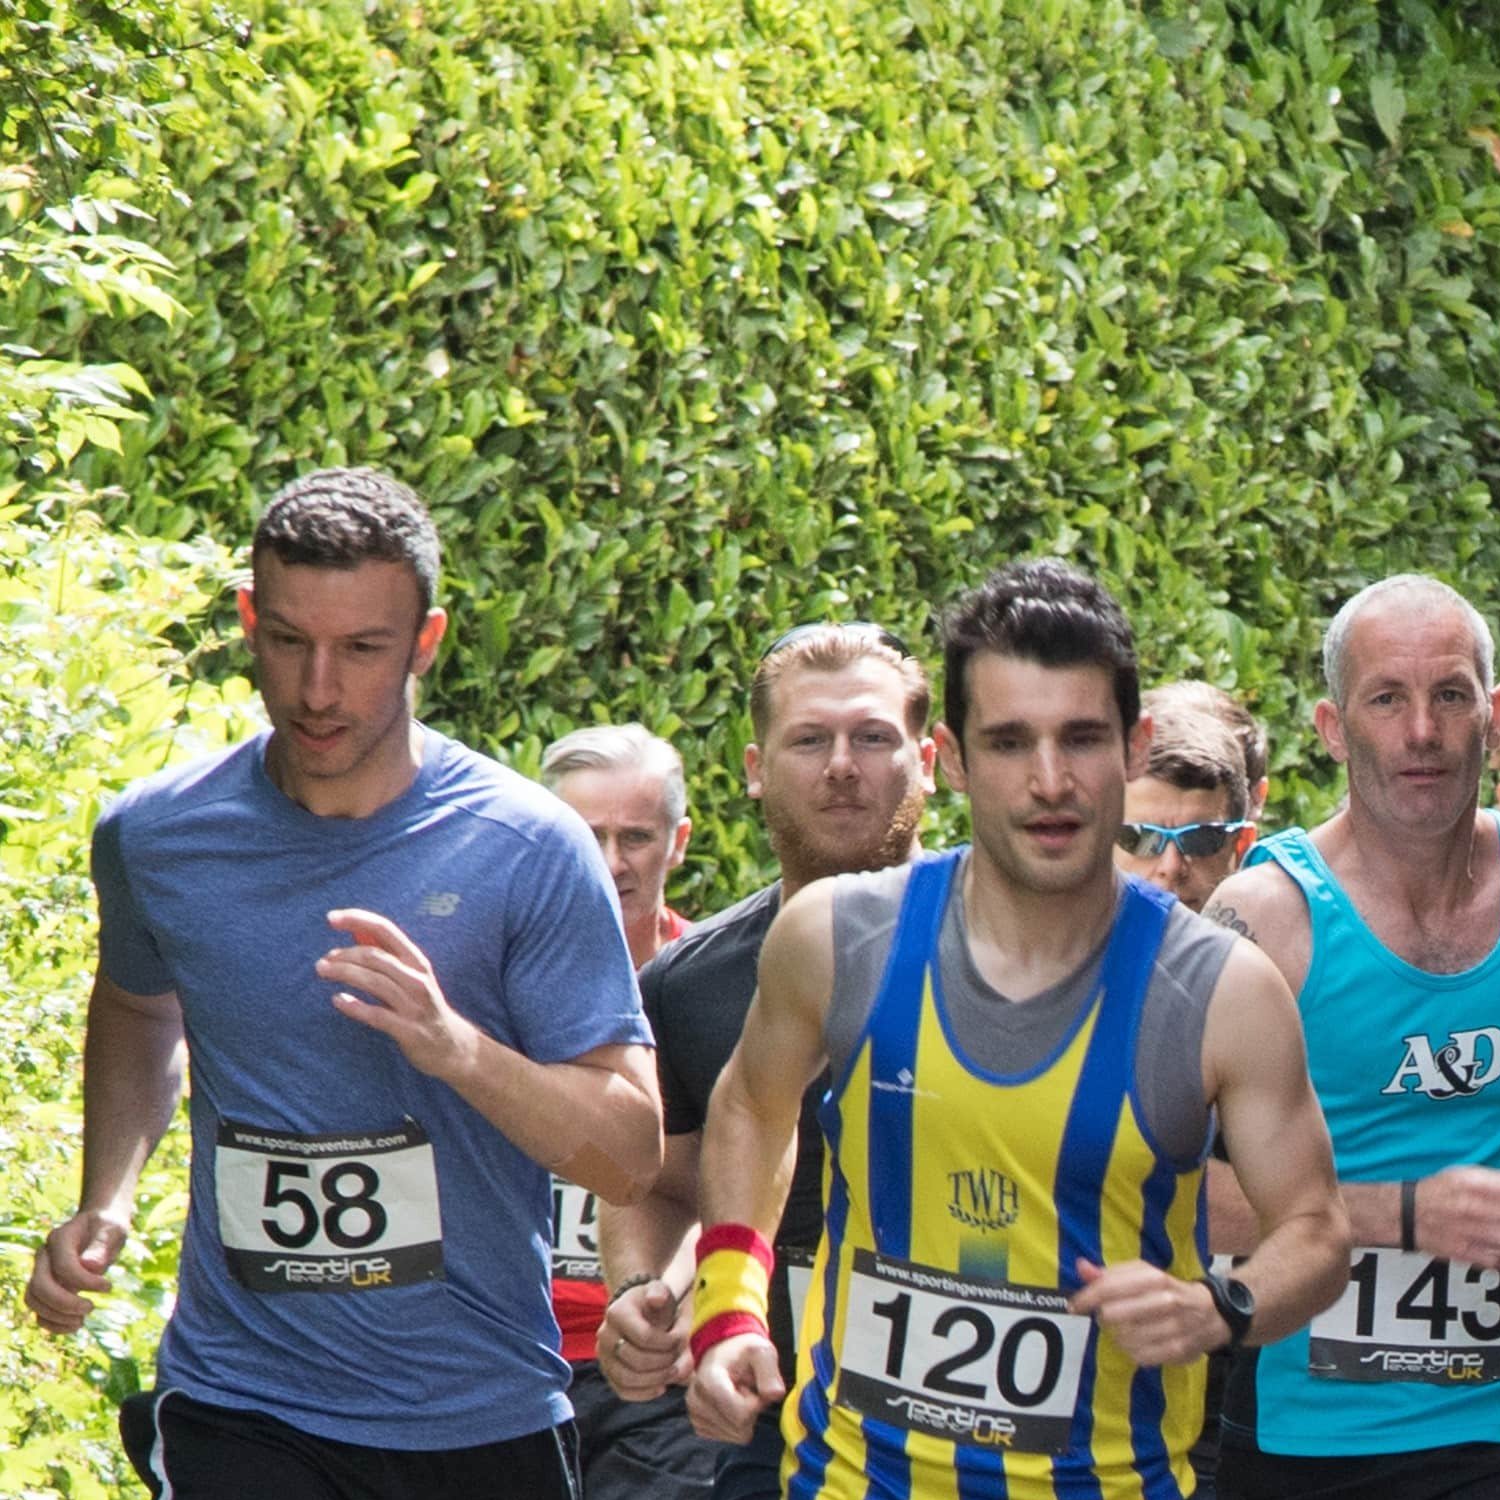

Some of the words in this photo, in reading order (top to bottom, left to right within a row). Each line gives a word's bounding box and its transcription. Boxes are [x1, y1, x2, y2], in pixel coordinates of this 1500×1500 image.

[233, 1132, 408, 1154] www.sportingeventsuk.com
[261, 1159, 388, 1250] 58
[948, 1167, 1019, 1217] TWH
[552, 1189, 599, 1252] 15
[264, 1257, 392, 1281] sporting
[352, 1270, 393, 1287] UK
[875, 1262, 1069, 1309] www.sportingeventsuk.com
[872, 1292, 1065, 1408] 120
[1360, 1350, 1485, 1374] sporting
[1447, 1366, 1483, 1380] UK
[886, 1395, 1017, 1435] sporting
[973, 1425, 1015, 1448] UK
